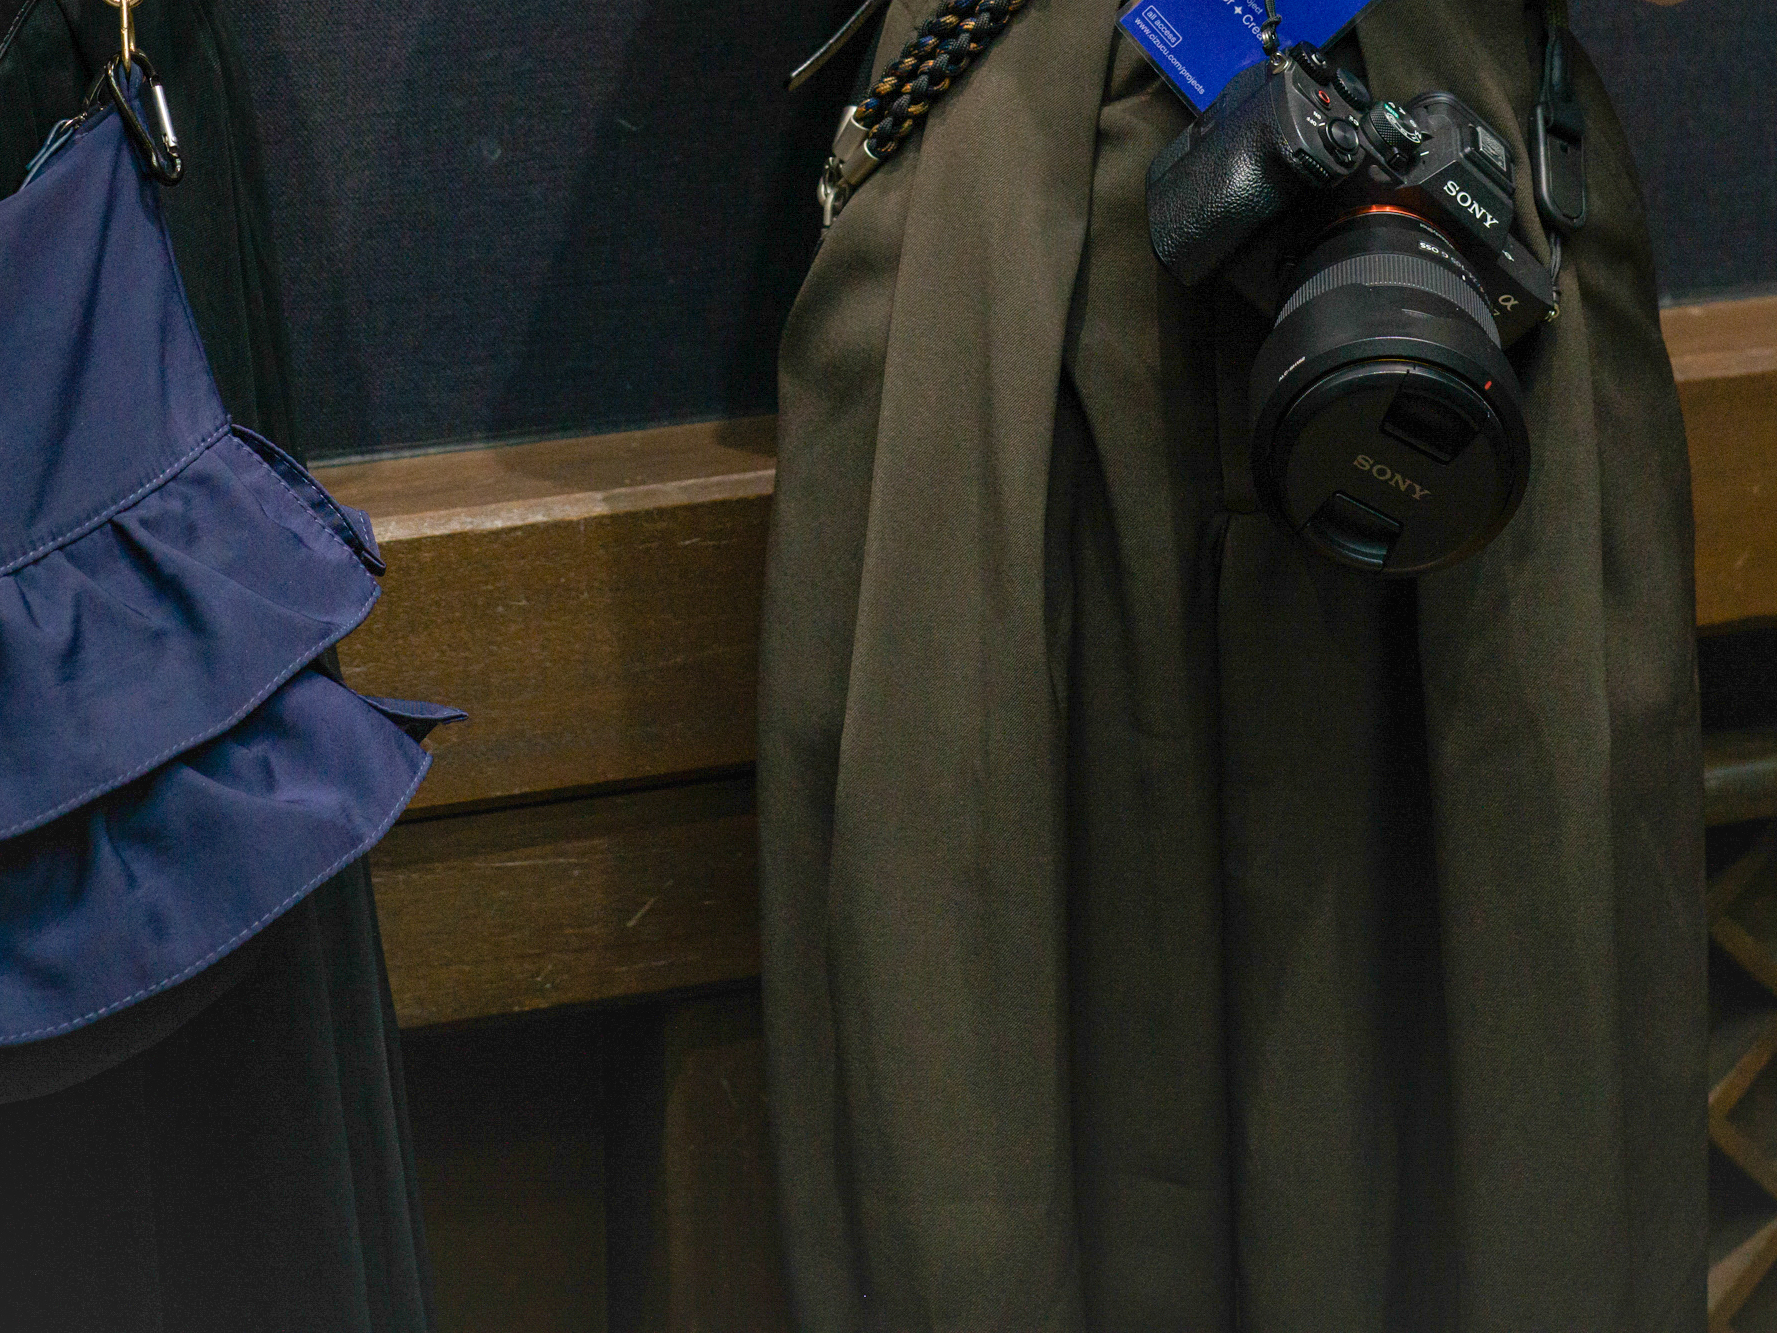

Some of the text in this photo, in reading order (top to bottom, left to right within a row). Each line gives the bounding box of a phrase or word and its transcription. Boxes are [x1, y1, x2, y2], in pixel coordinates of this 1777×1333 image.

[1146, 10, 1177, 43] all access
[1241, 14, 1265, 44] Crea
[1134, 17, 1206, 95] www.cizucu.com/projects
[1443, 180, 1499, 229] SONY
[1353, 454, 1432, 501] SONY
